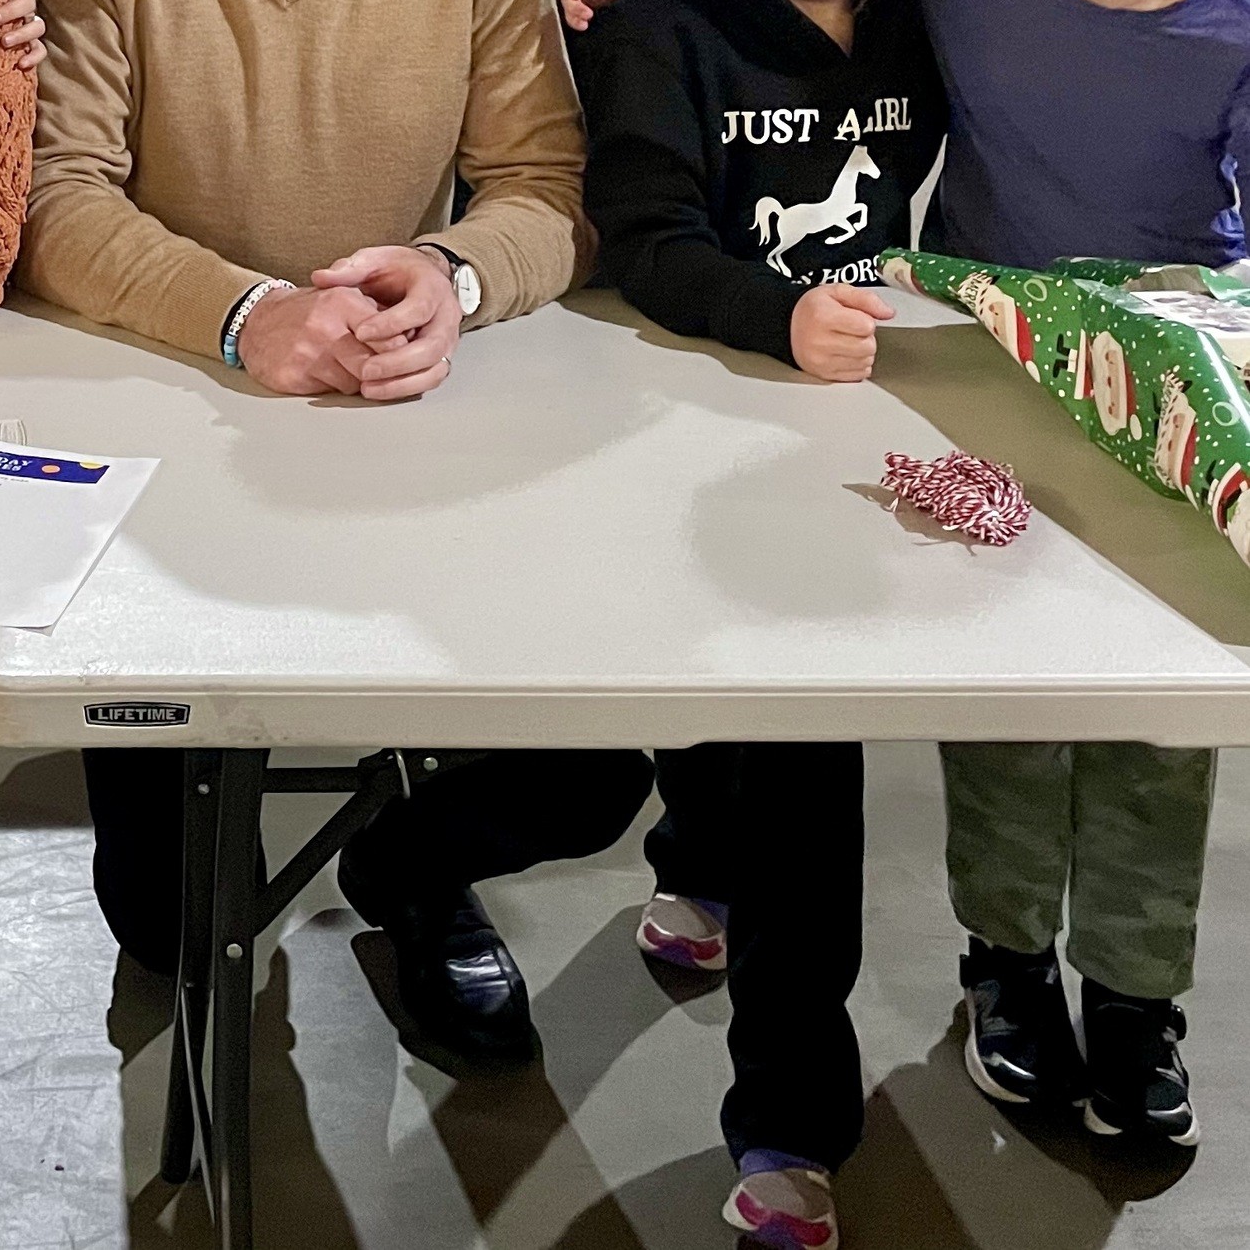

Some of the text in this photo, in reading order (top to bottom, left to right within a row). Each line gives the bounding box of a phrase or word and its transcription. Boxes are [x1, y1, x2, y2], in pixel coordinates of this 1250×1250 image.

[721, 108, 819, 145] JUST
[834, 108, 861, 141] A
[97, 708, 178, 721] LIFETIME
